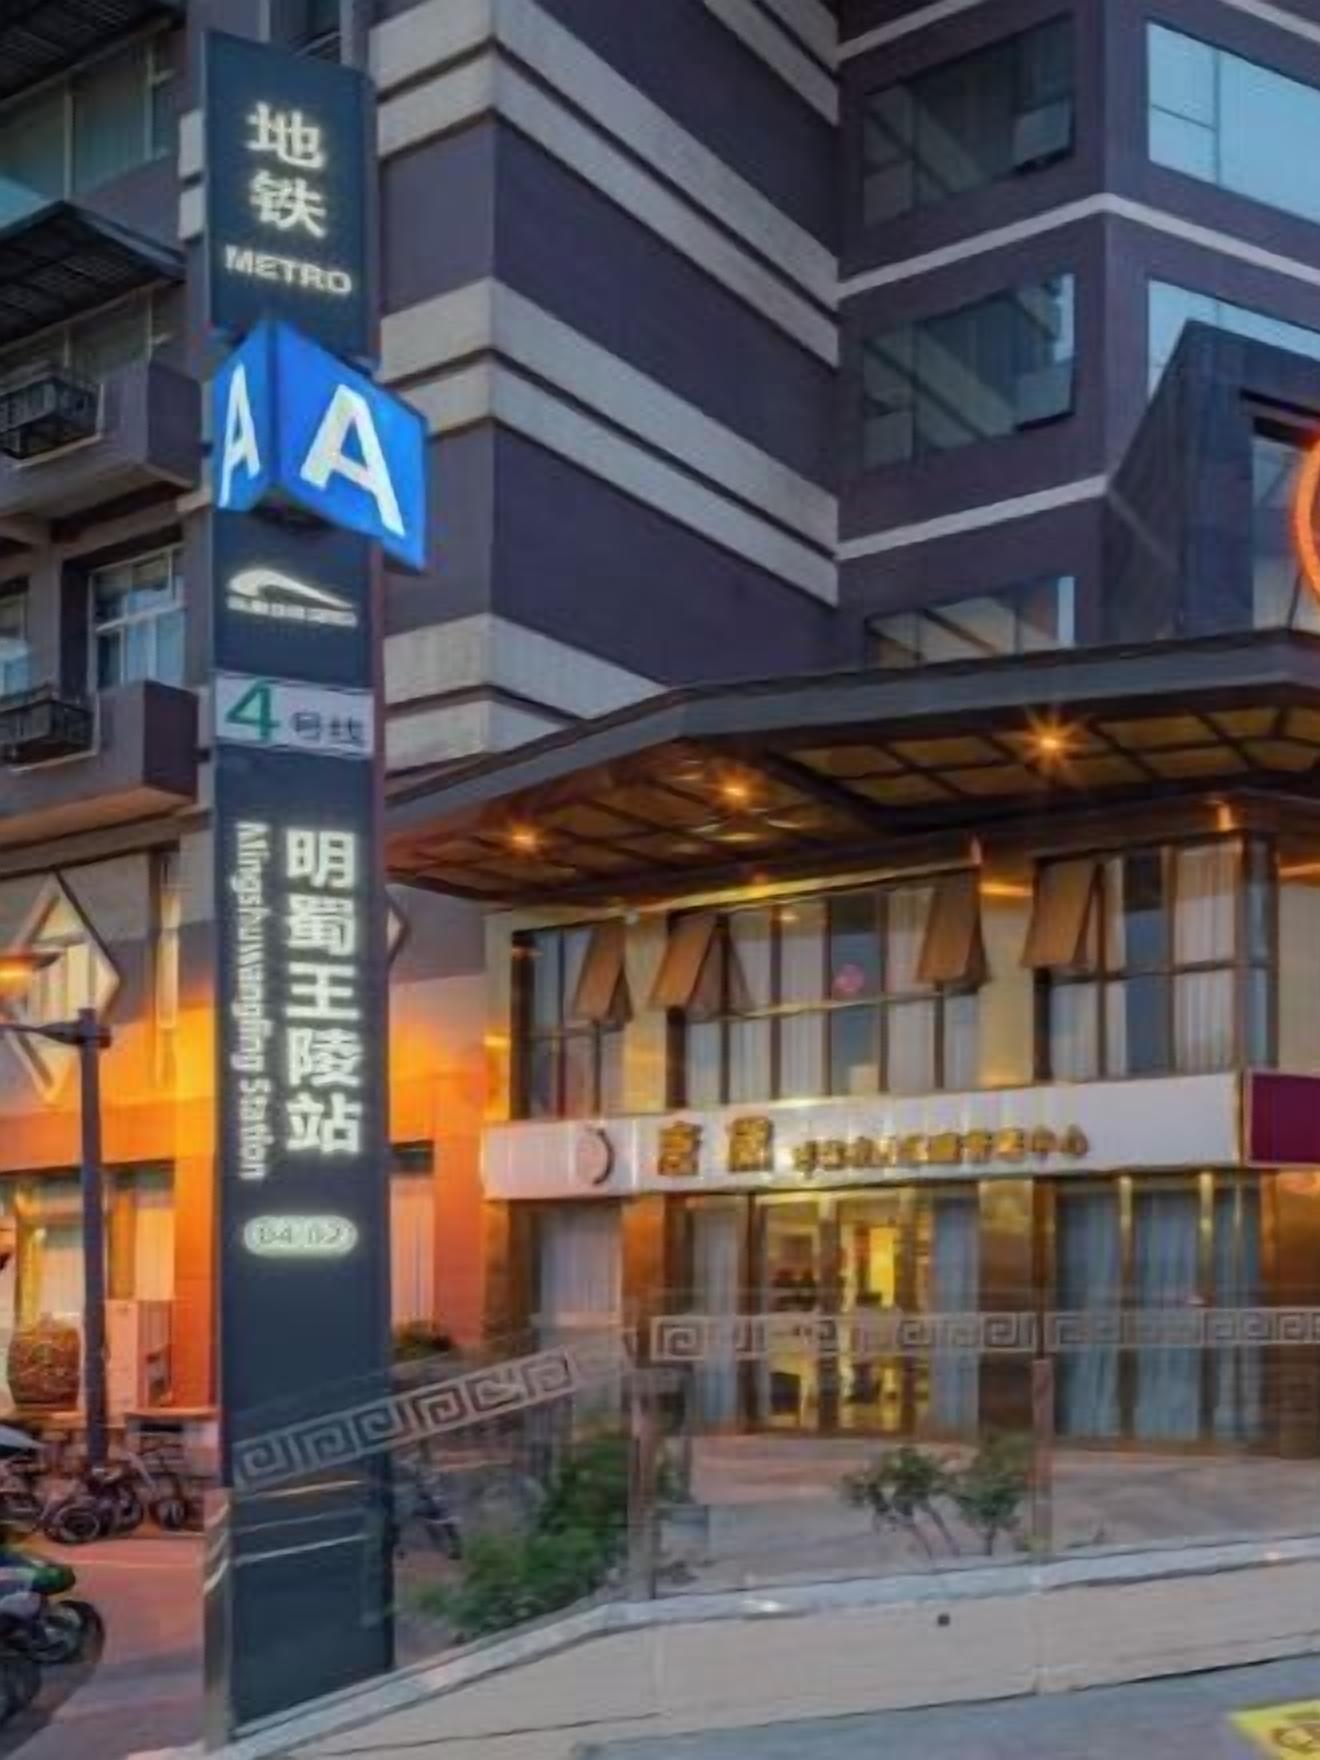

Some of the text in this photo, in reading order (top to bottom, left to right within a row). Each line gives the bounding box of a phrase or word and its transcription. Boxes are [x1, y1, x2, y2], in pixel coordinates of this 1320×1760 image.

[246, 102, 327, 238] 地铁
[224, 244, 353, 296] METRO
[217, 362, 261, 508] A
[301, 383, 406, 538] A
[284, 828, 364, 1156] 明蜀王陵站
[236, 1078, 275, 1181] Station
